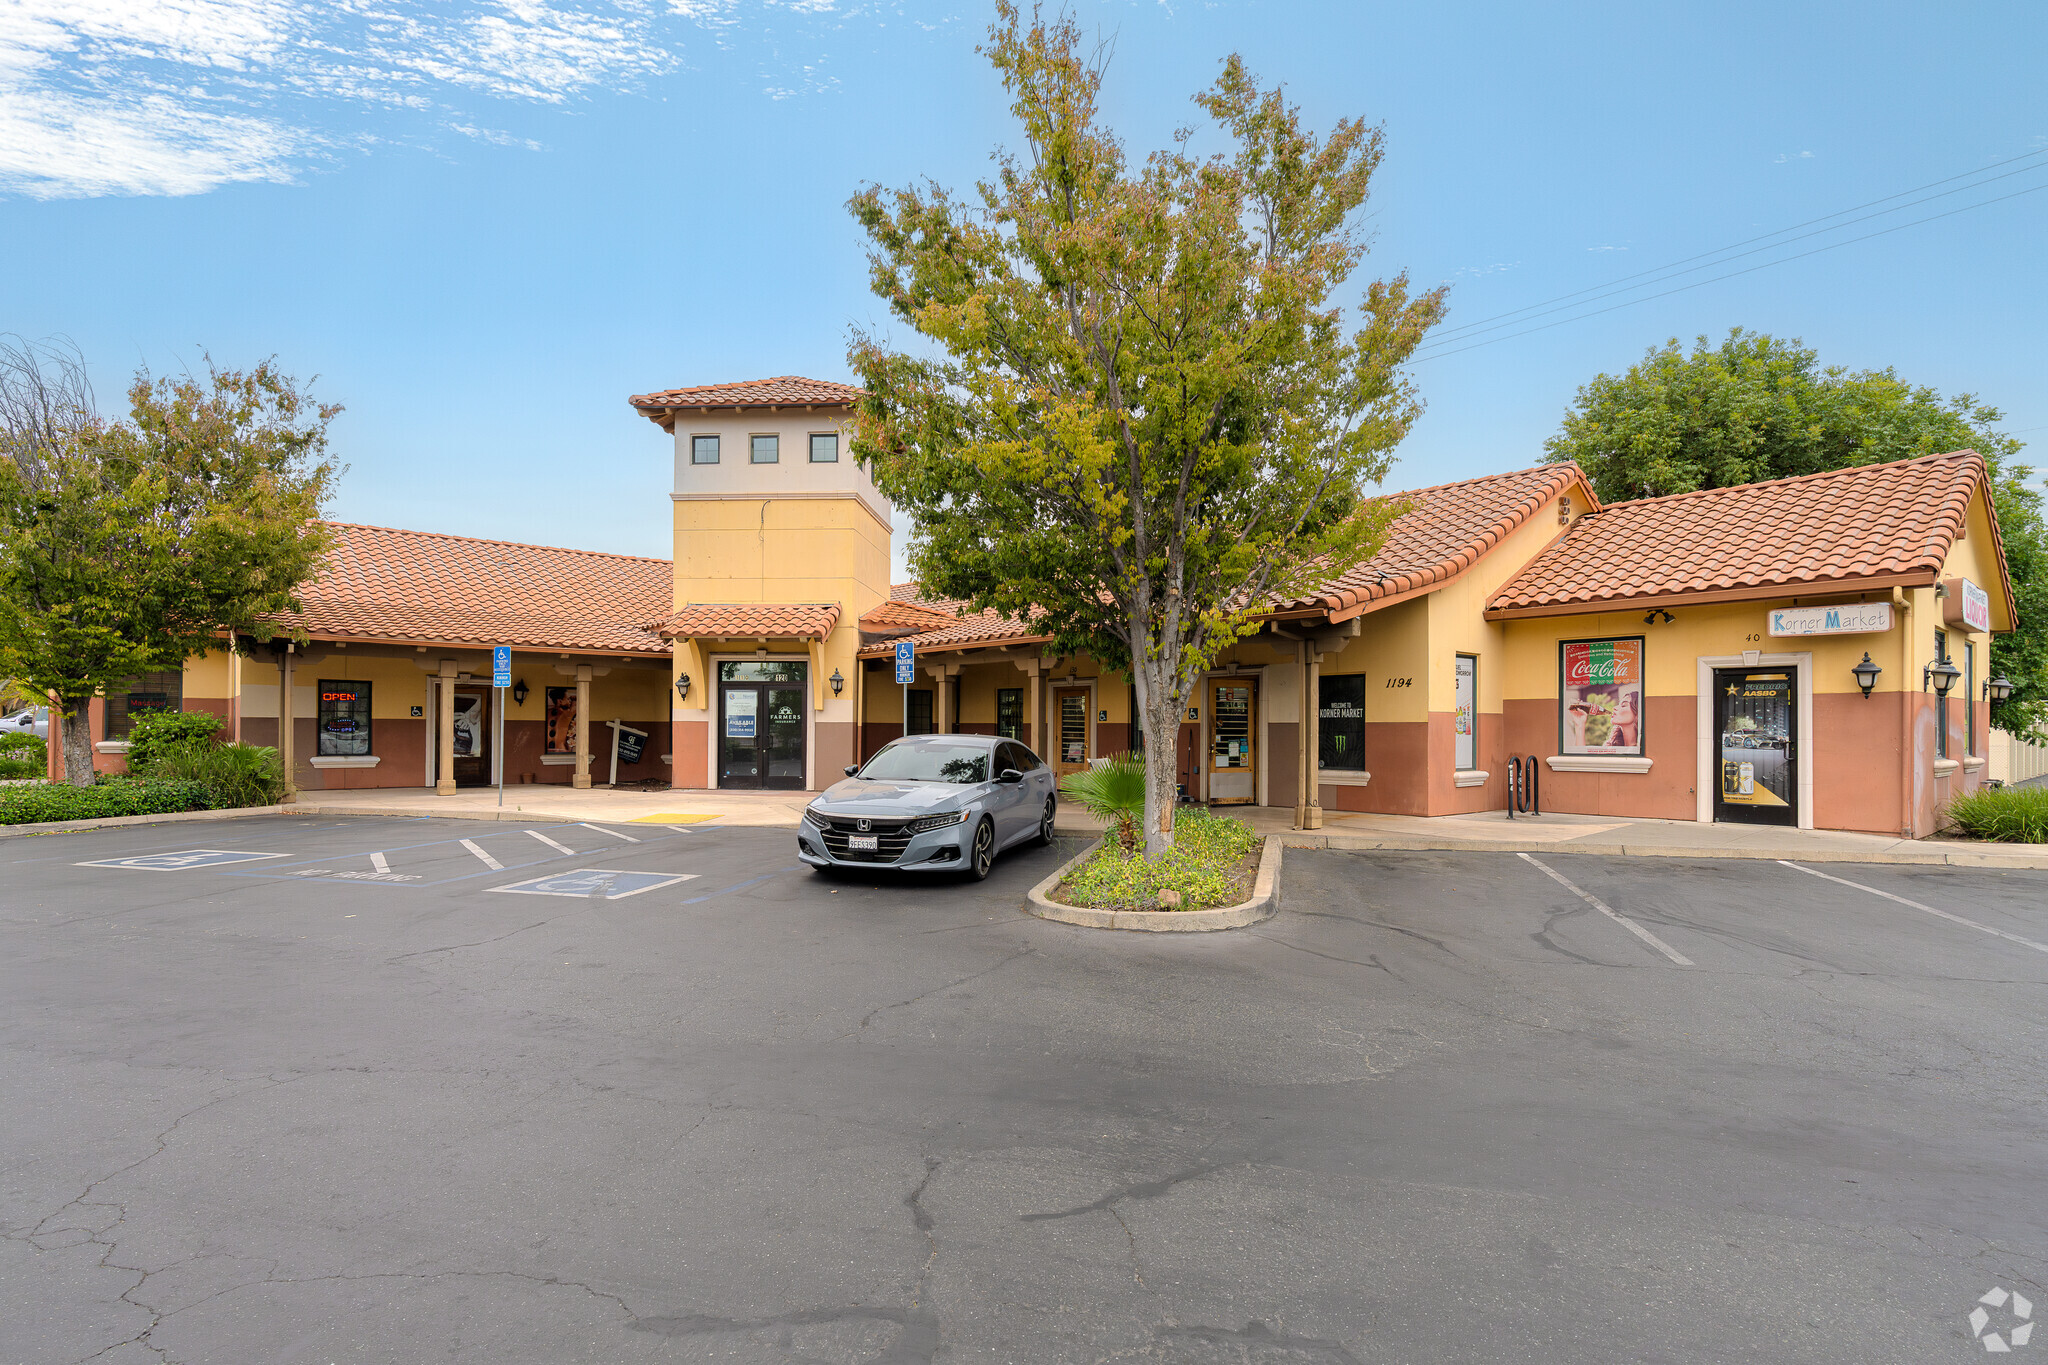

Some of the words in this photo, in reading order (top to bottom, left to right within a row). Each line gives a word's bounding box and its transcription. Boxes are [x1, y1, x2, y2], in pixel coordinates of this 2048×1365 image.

[1966, 596, 1987, 628] LIQUOR
[1774, 613, 1822, 631] Korner
[1825, 610, 1886, 629] Market
[1745, 633, 1760, 642] 40
[1572, 658, 1632, 678] Coca-Cola
[1386, 677, 1412, 688] 1194
[322, 693, 355, 701] OPEN
[1320, 708, 1340, 718] KORNER
[1341, 708, 1363, 718] MARKET
